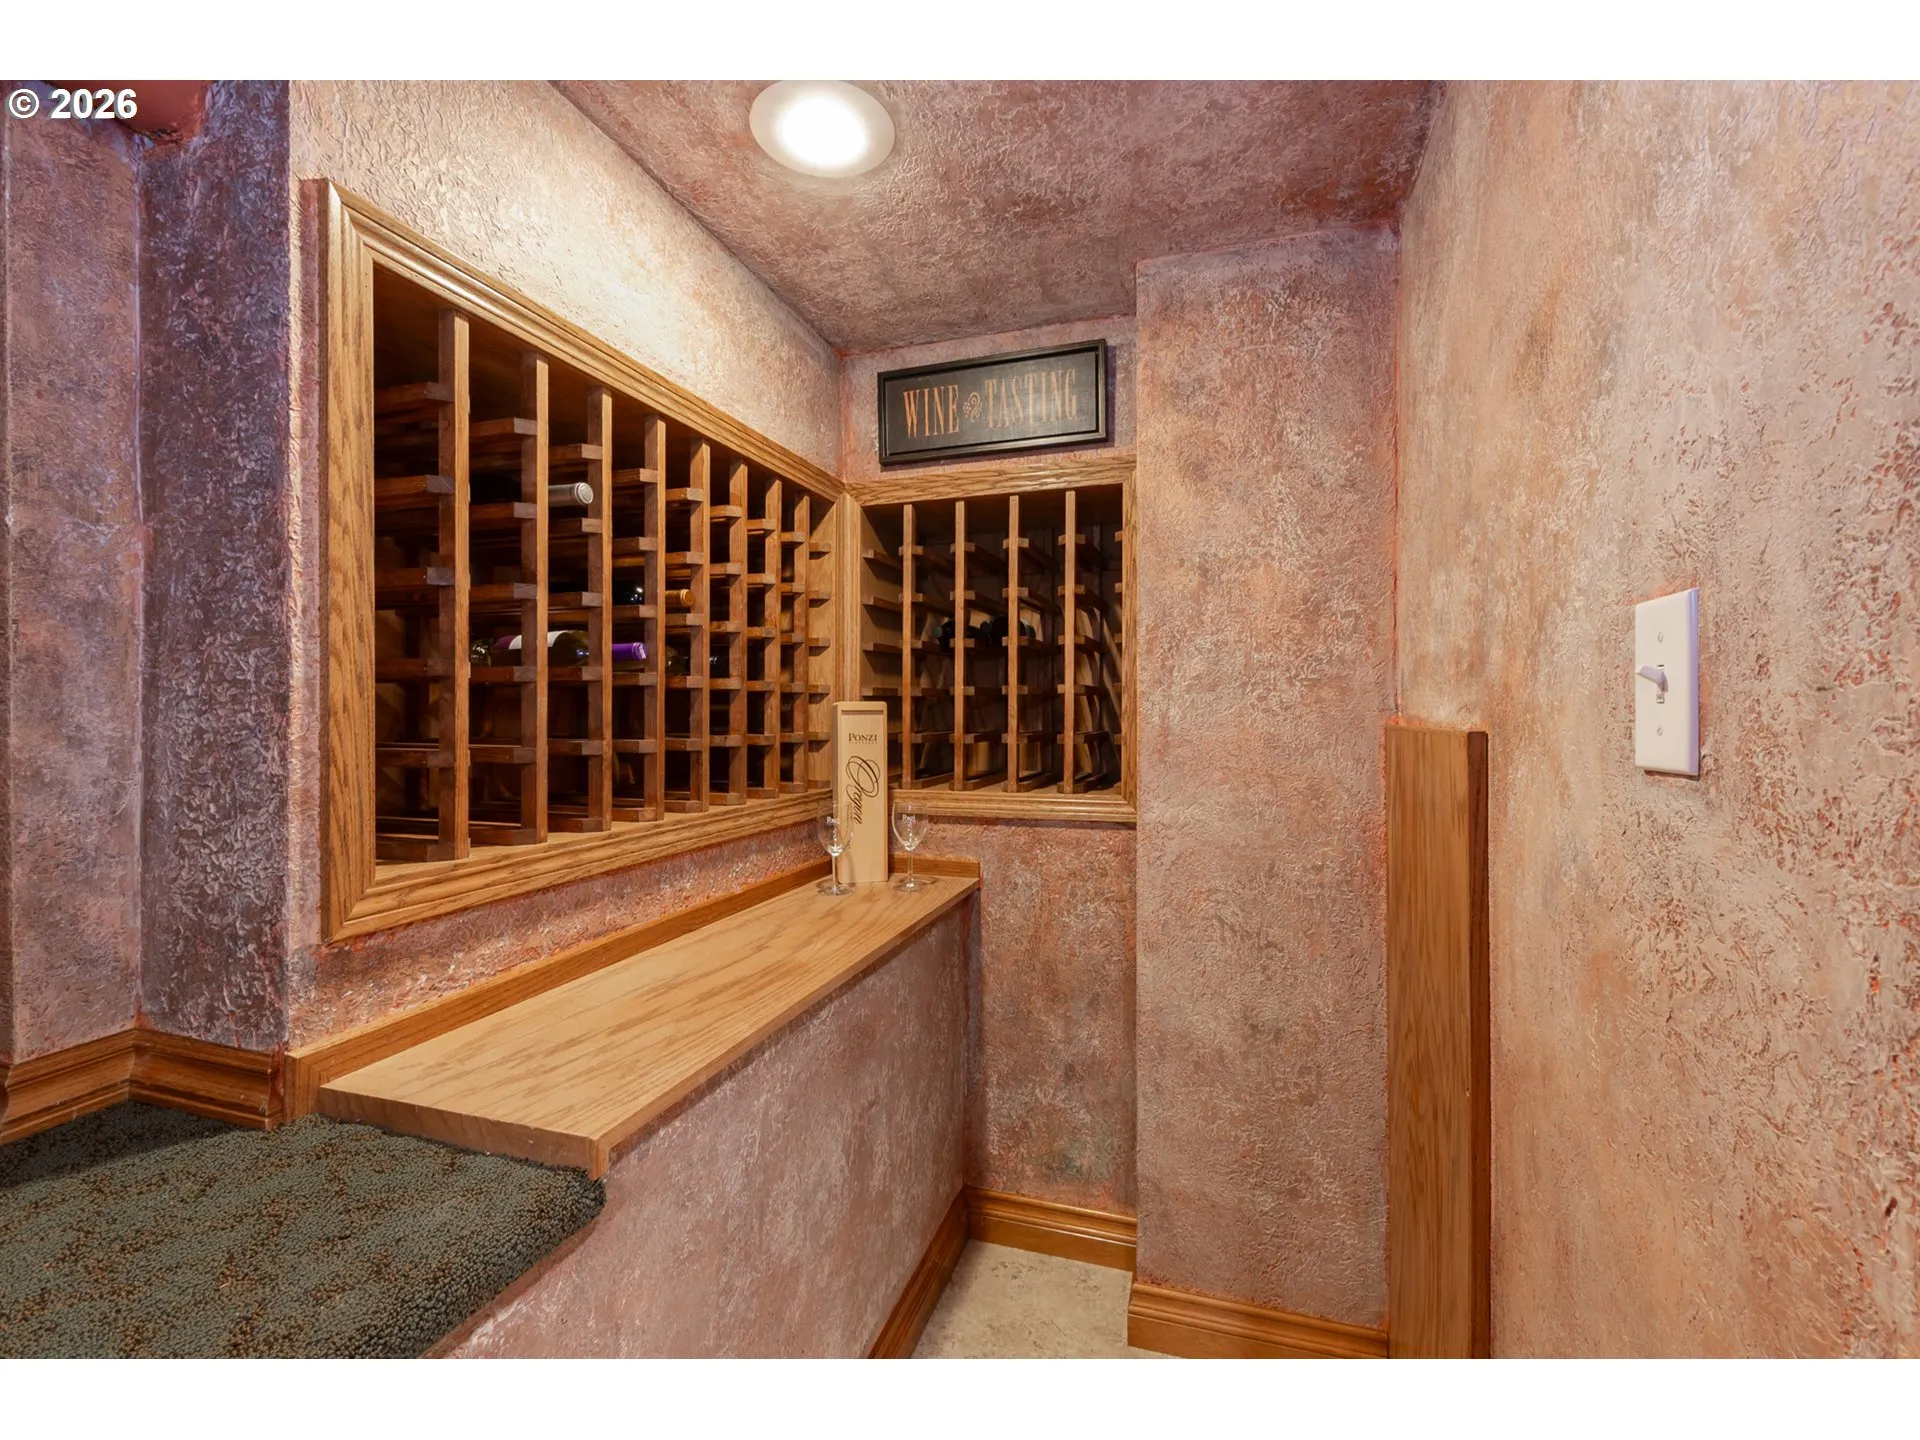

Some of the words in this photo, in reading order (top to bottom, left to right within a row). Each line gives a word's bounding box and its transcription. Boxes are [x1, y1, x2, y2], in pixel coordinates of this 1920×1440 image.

[903, 385, 960, 440] WINE
[985, 368, 1078, 429] TASTING
[848, 733, 877, 741] PONZI
[846, 756, 881, 824] Oregon
